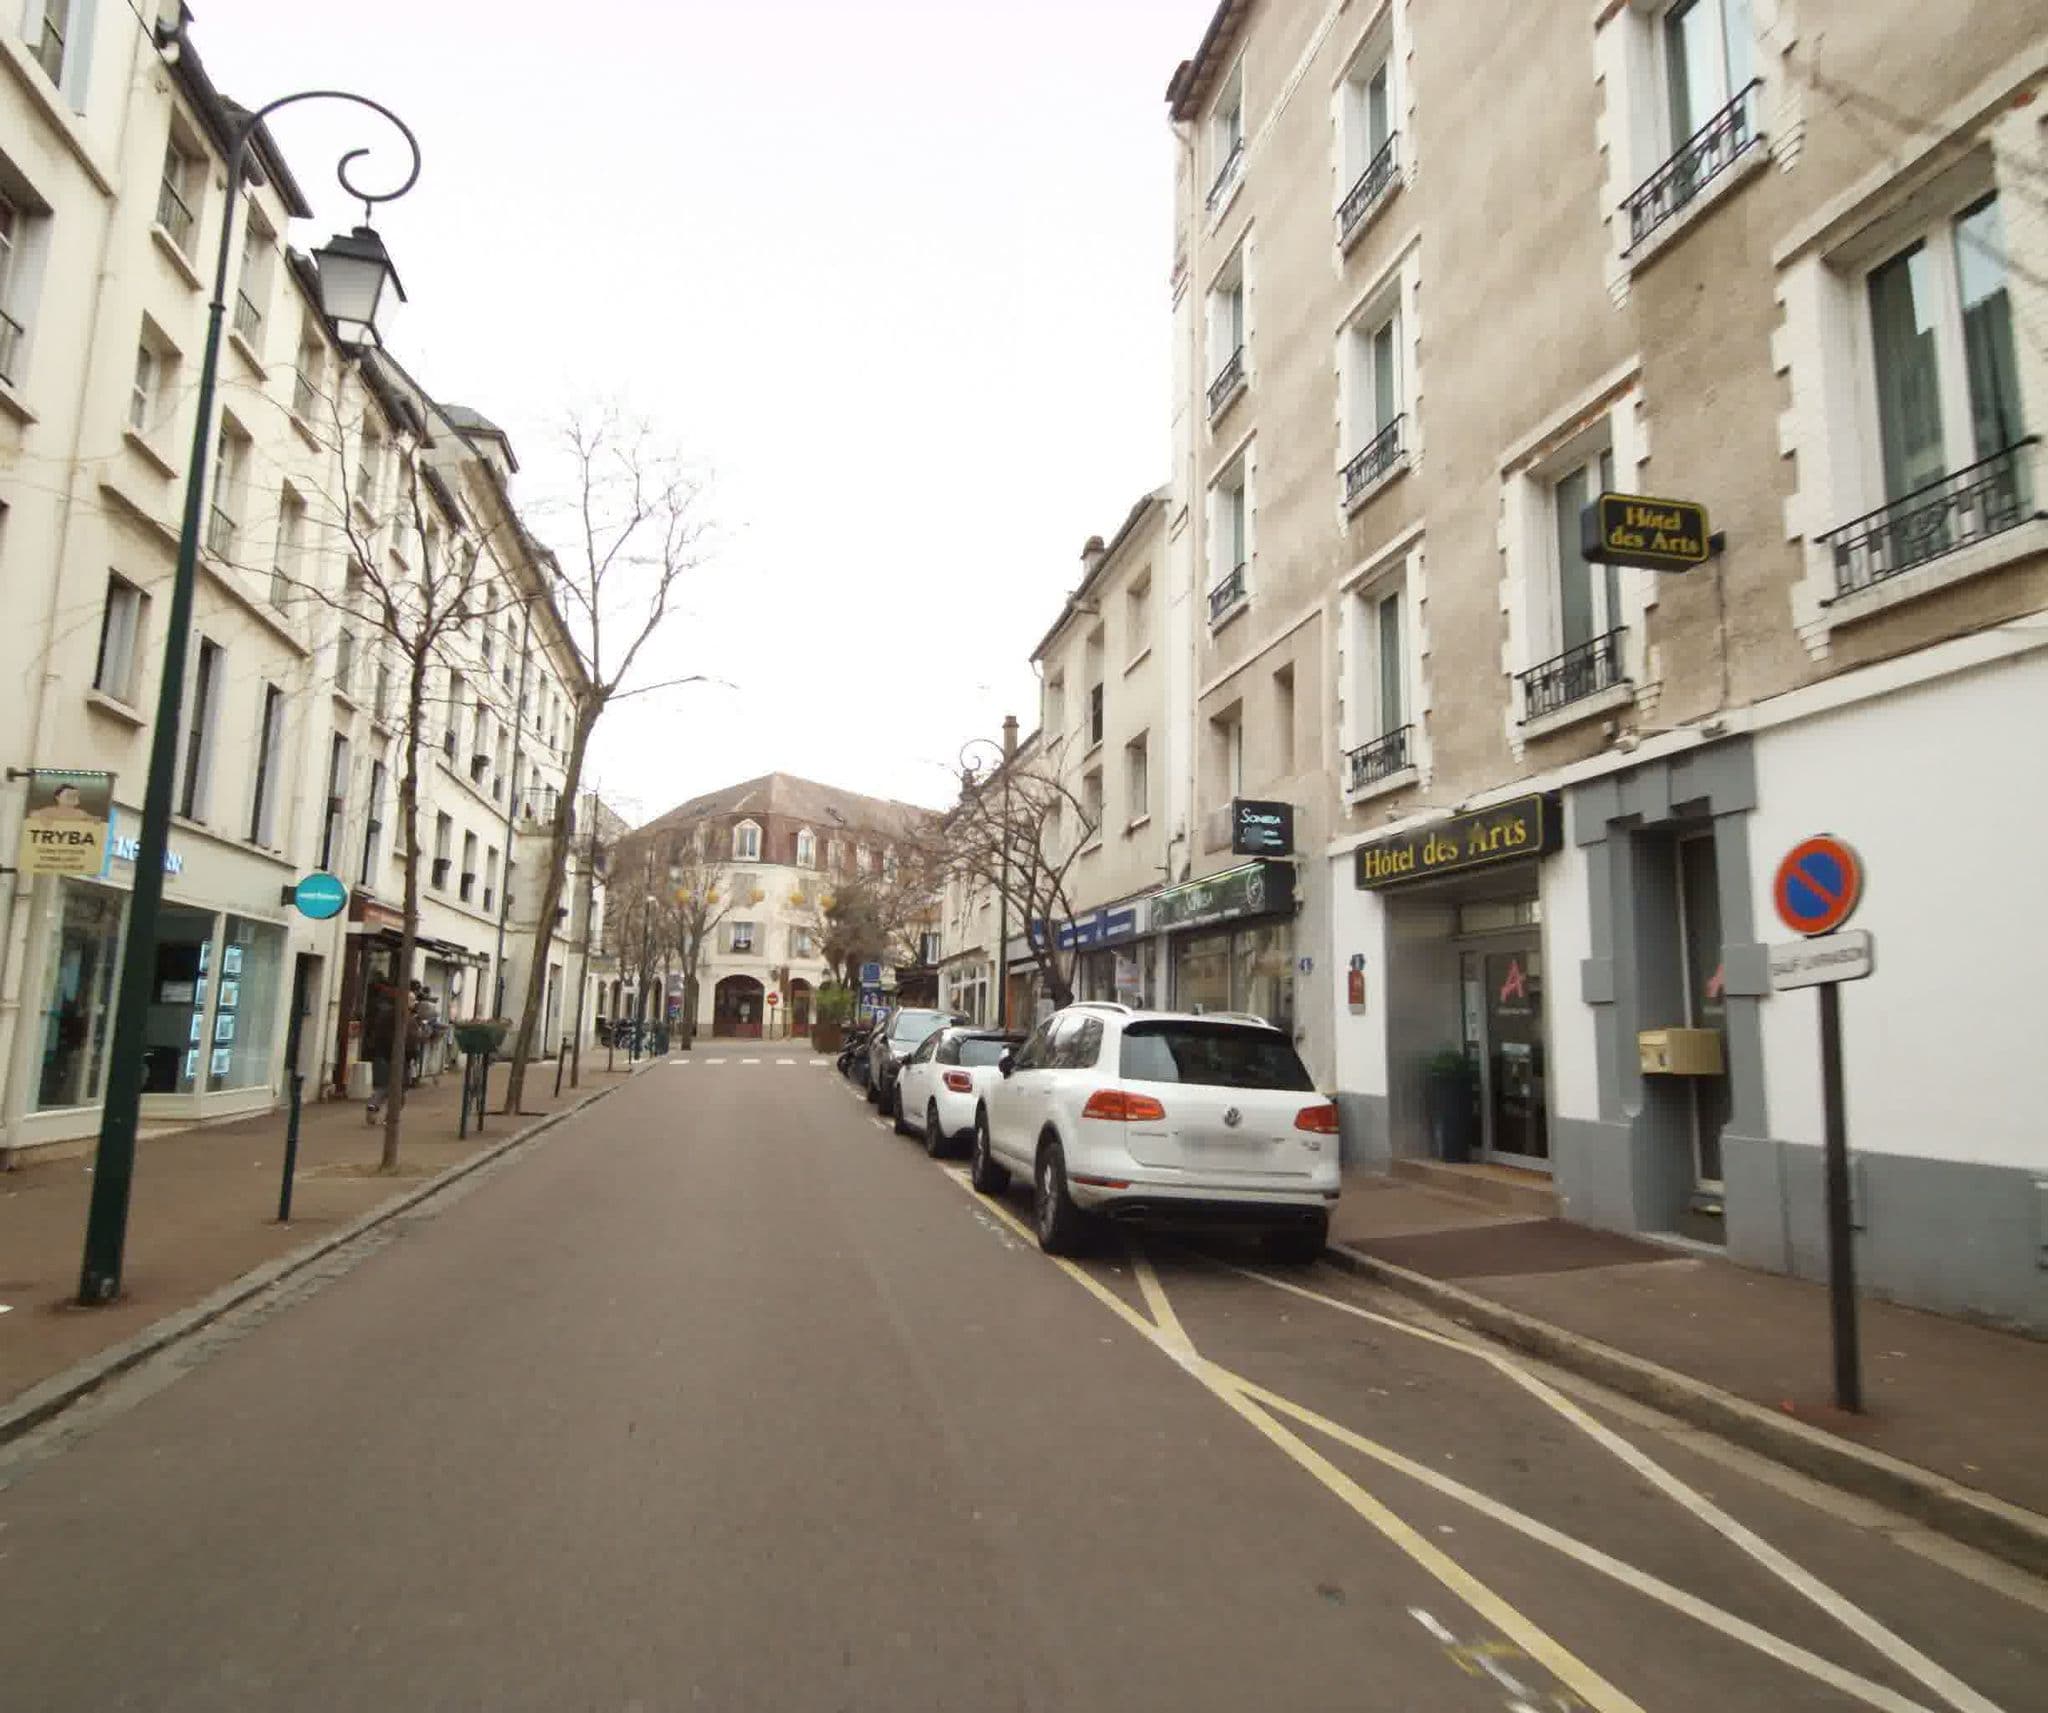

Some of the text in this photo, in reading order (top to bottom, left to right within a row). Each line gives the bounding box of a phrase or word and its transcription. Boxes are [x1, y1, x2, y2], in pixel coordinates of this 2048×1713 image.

[1611, 525, 1699, 553] des Arts
[29, 829, 96, 846] TRYBA
[1423, 832, 1459, 865] des
[1468, 818, 1528, 856] Arts
